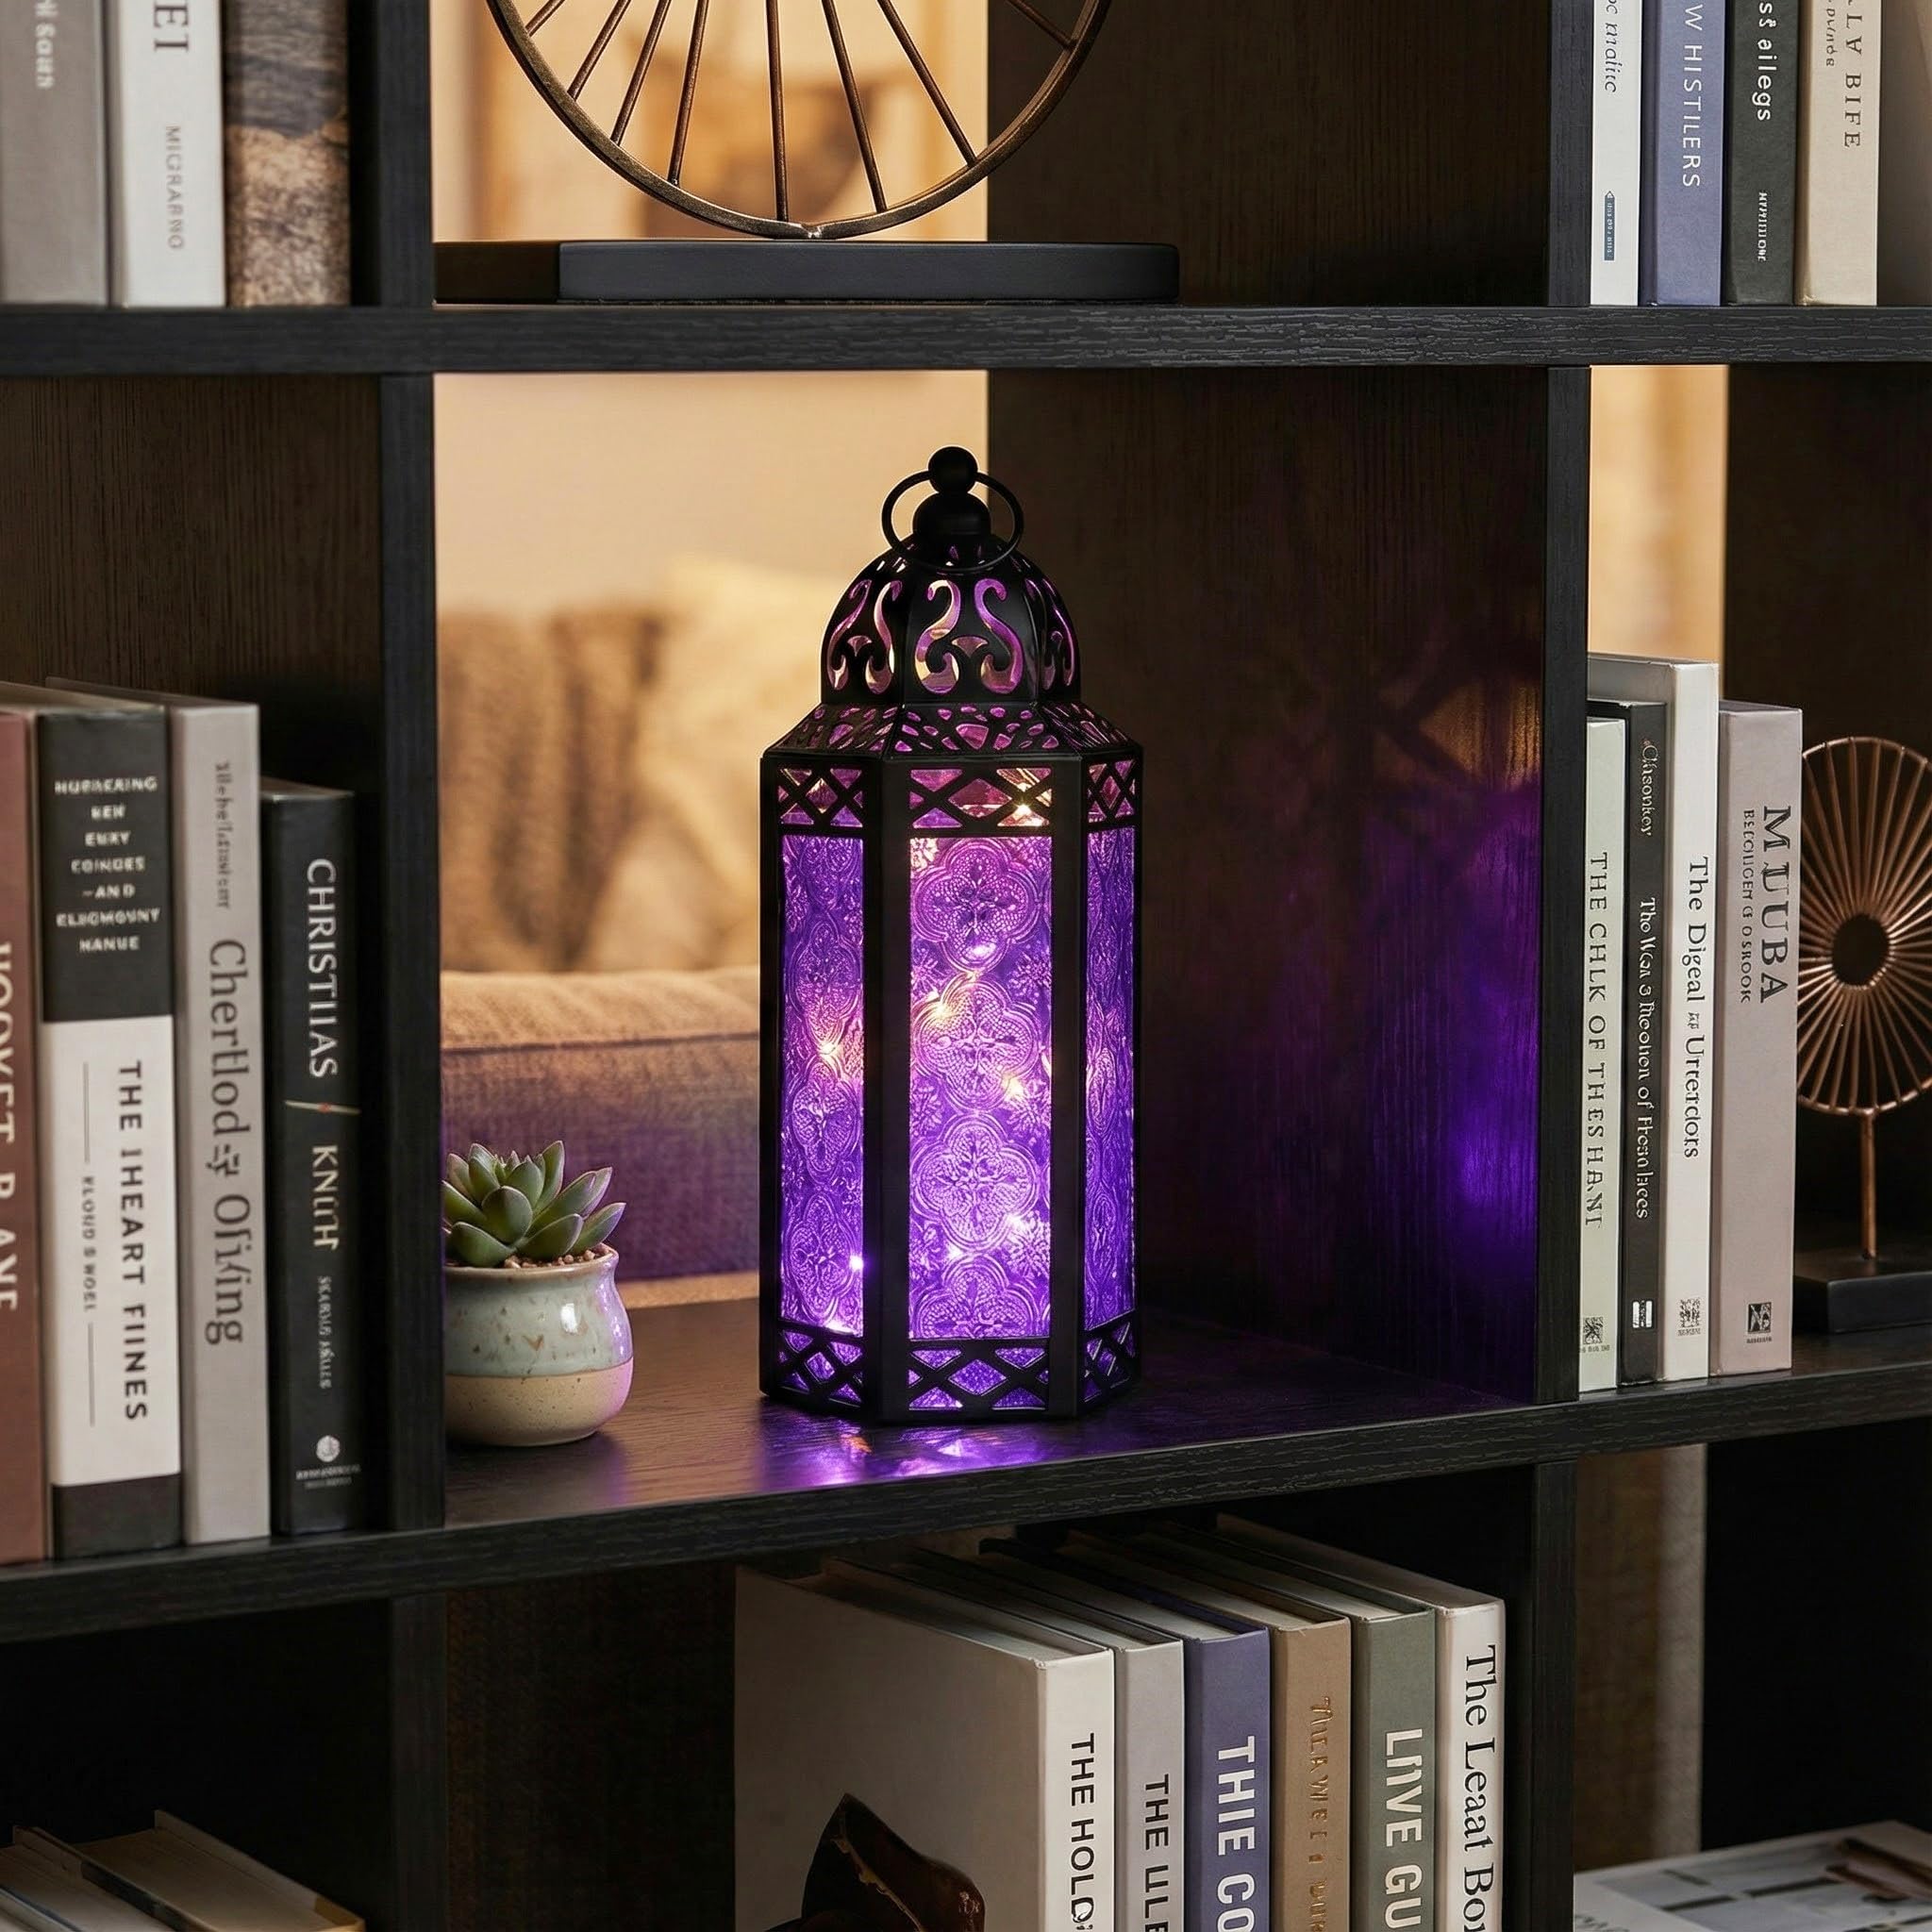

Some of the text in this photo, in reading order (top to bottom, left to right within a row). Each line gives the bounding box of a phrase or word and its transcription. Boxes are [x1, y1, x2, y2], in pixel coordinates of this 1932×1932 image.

[1682, 44, 1704, 188] HISTILERS
[1844, 72, 1862, 148] BIFE
[1590, 852, 1608, 910] THE
[1689, 857, 1709, 911] The
[1589, 924, 1607, 1003] CHLK
[1681, 923, 1707, 1003] Digeal
[1589, 1015, 1607, 1050] OF
[118, 1059, 143, 1132] THE
[1637, 1086, 1654, 1108] of
[1464, 1644, 1497, 1727] The
[1071, 1733, 1095, 1807] THE
[1218, 1735, 1257, 1857] THIE
[1464, 1737, 1496, 1853] Leaat
[1144, 1774, 1169, 1851] THE
